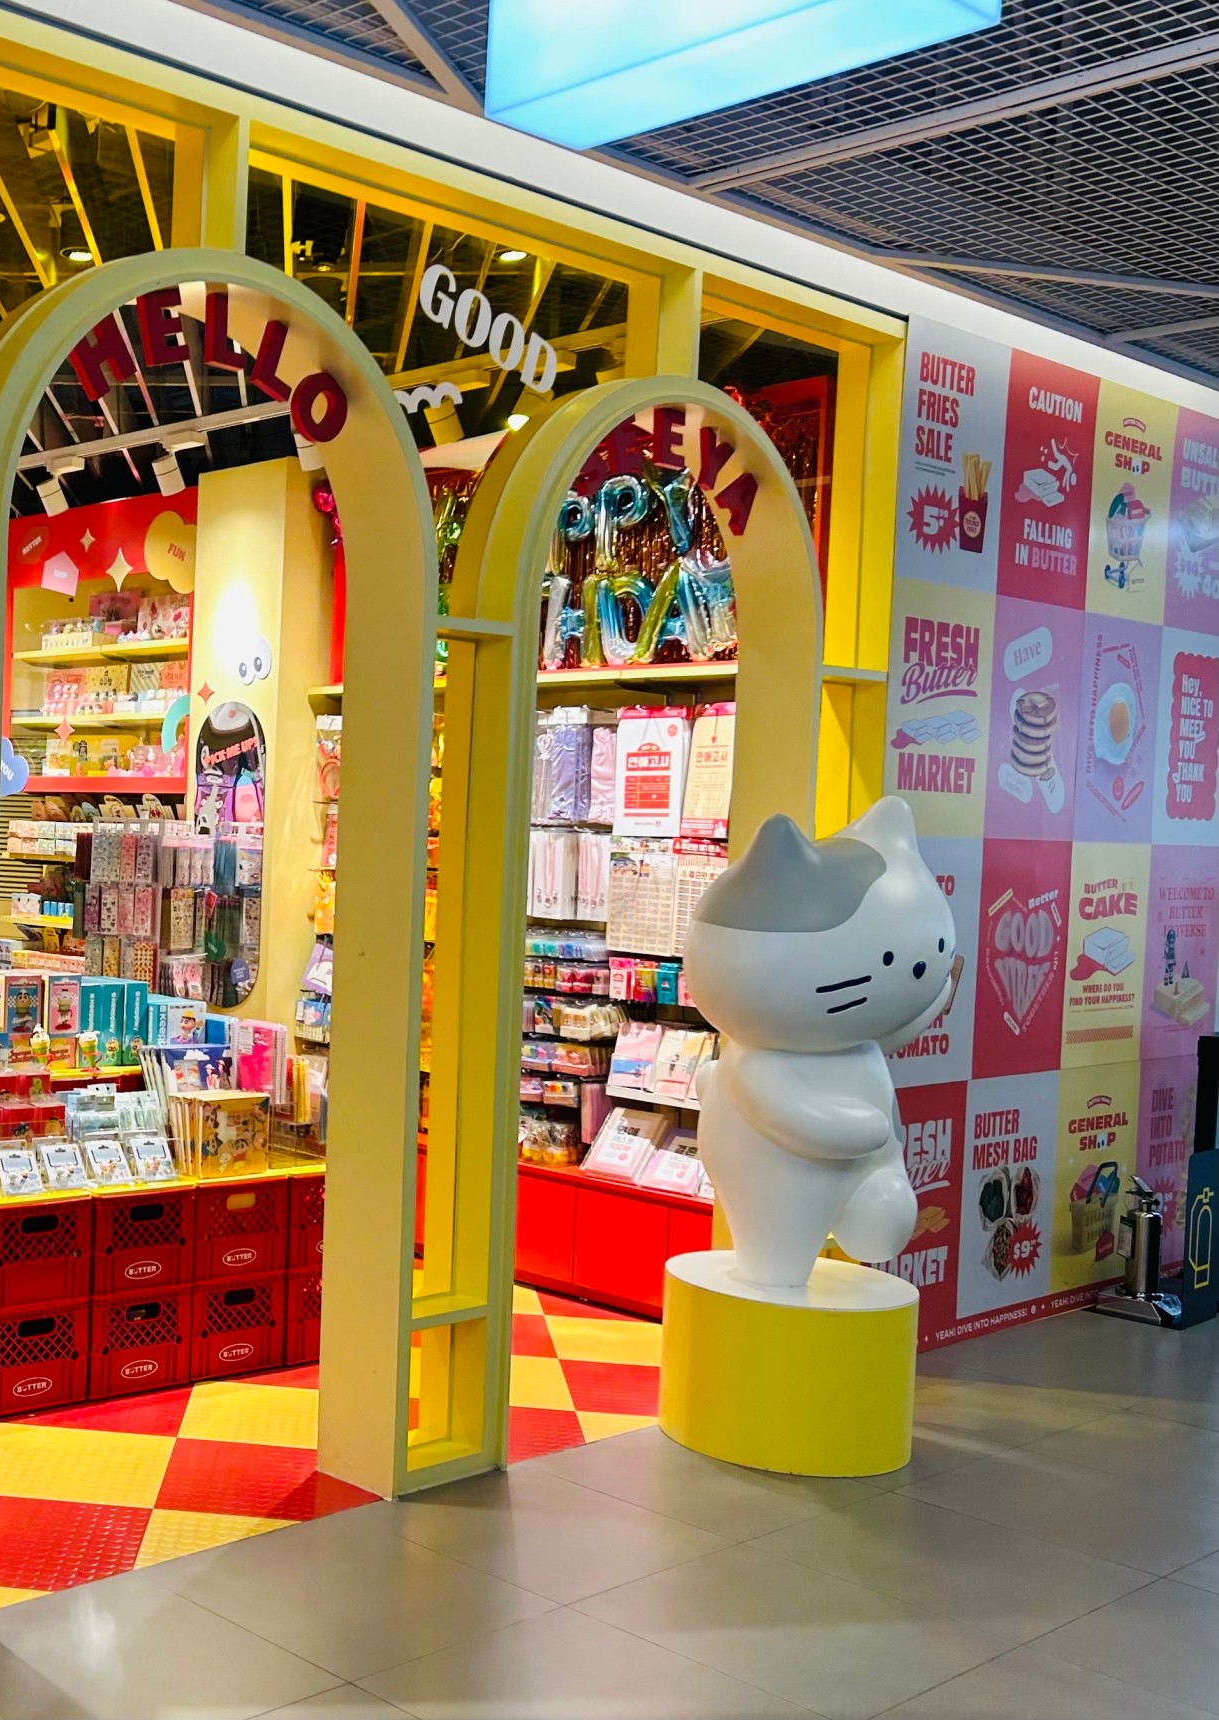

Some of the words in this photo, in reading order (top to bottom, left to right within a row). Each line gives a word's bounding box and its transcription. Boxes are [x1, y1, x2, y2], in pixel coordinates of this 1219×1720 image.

[419, 263, 557, 393] GOOD
[69, 285, 348, 443] HELLO
[919, 351, 976, 397] BUTTER
[917, 388, 960, 429] FRIES
[1028, 386, 1083, 423] CAUTION
[915, 425, 953, 463] SALE
[1104, 431, 1162, 462] GENERAL
[1023, 518, 1073, 549] FALLING
[167, 543, 186, 562] FUN
[1014, 542, 1029, 566] IN
[1031, 547, 1078, 576] BUTTER
[903, 616, 980, 672] FRESH
[1013, 640, 1042, 668] Have
[900, 661, 979, 705] Butter
[1182, 674, 1203, 697] Hey,
[1181, 695, 1201, 716] NICE
[1203, 699, 1214, 718] TO
[1179, 718, 1205, 743] MEET
[627, 755, 670, 769] 연애고사
[1179, 740, 1196, 760] YOU
[897, 752, 976, 794] MARKET
[1172, 762, 1205, 784] THANK
[1176, 783, 1193, 804] YOU
[1028, 889, 1059, 909] Better
[1084, 879, 1118, 894] BUTTER
[1159, 888, 1202, 900] WELCOME
[1203, 887, 1215, 900] TO
[1078, 892, 1138, 920] CAKE
[1169, 906, 1203, 919] BUTTER
[994, 909, 1055, 958] GOOD
[1021, 971, 1055, 1033] TOGETHER
[1069, 996, 1083, 1007] FIND
[1084, 995, 1100, 1006] YOUR
[1101, 993, 1135, 1005] HAPPINESS?
[1083, 984, 1103, 994] WHERE
[1103, 983, 1112, 993] DO
[1113, 983, 1124, 992] YOU
[1151, 1087, 1174, 1113] DIVE
[973, 1108, 1020, 1140] BUTTER
[1068, 1112, 1128, 1134] GENERAL
[1150, 1115, 1173, 1140] INTO
[972, 1140, 1010, 1171] MESH
[1012, 1136, 1038, 1164] BAG
[1148, 1140, 1186, 1168] POTATO
[1050, 1297, 1069, 1309] YEAH!
[1069, 1293, 1084, 1304] DIVE
[935, 1329, 957, 1341] YEAH!
[957, 1324, 973, 1336] DIVE
[973, 1318, 989, 1331] INTO
[990, 1307, 1028, 1326] HAPPINESS!
